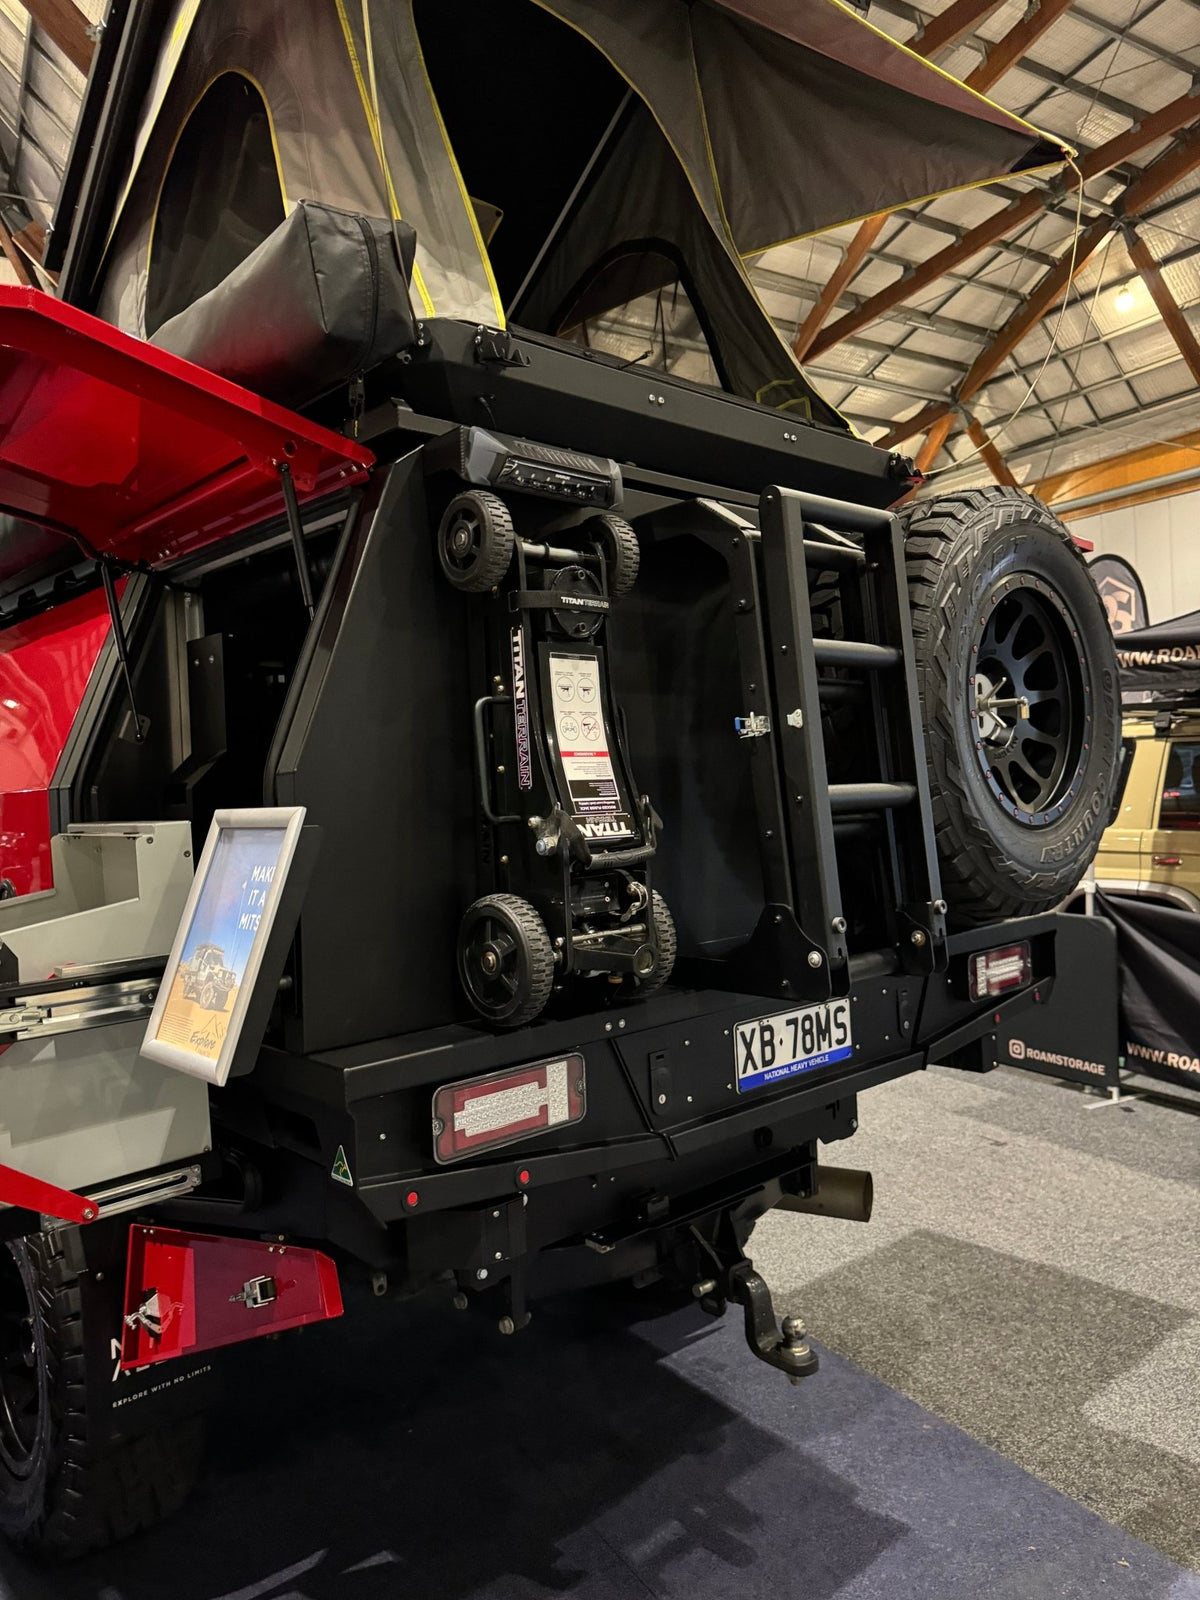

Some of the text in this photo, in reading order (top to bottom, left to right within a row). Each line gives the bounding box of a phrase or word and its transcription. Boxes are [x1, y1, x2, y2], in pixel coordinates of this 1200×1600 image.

[512, 629, 531, 786] TITAN TERRAIN
[247, 889, 259, 906] IT
[190, 1030, 217, 1053] Explore
[763, 1054, 830, 1081] NATIONAL HEAVY VEHICLE
[1026, 1047, 1107, 1076] ROAMSTORAGE
[112, 1389, 148, 1408] EXPLORE
[151, 1381, 172, 1394] WITH
[173, 1376, 185, 1384] NO
[186, 1364, 212, 1379] LIMITS
